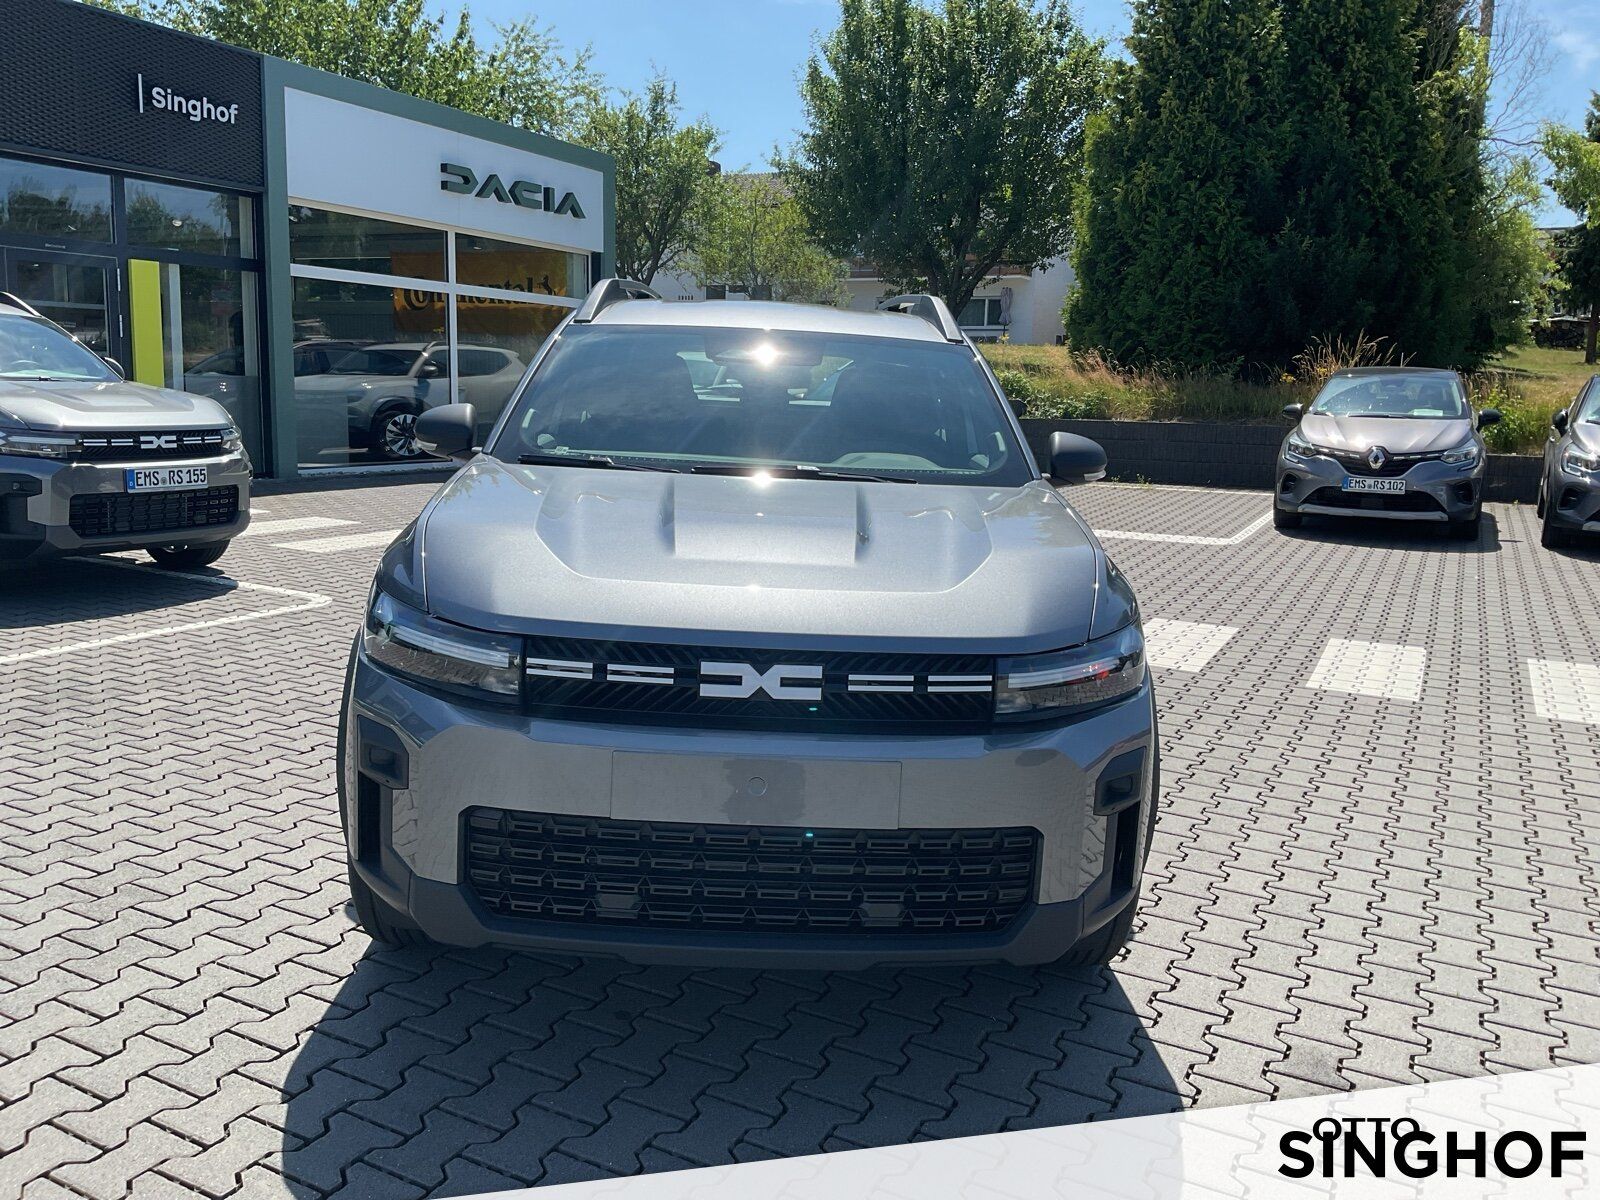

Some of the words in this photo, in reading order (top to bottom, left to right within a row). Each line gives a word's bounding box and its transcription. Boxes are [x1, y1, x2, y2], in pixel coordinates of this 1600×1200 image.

[151, 86, 239, 125] Singhof
[440, 162, 587, 219] DACIA
[135, 471, 160, 487] EMS
[168, 469, 184, 485] RS
[186, 468, 206, 484] 155
[1348, 478, 1366, 489] EMS
[1373, 480, 1386, 490] RS
[1386, 480, 1404, 491] 102
